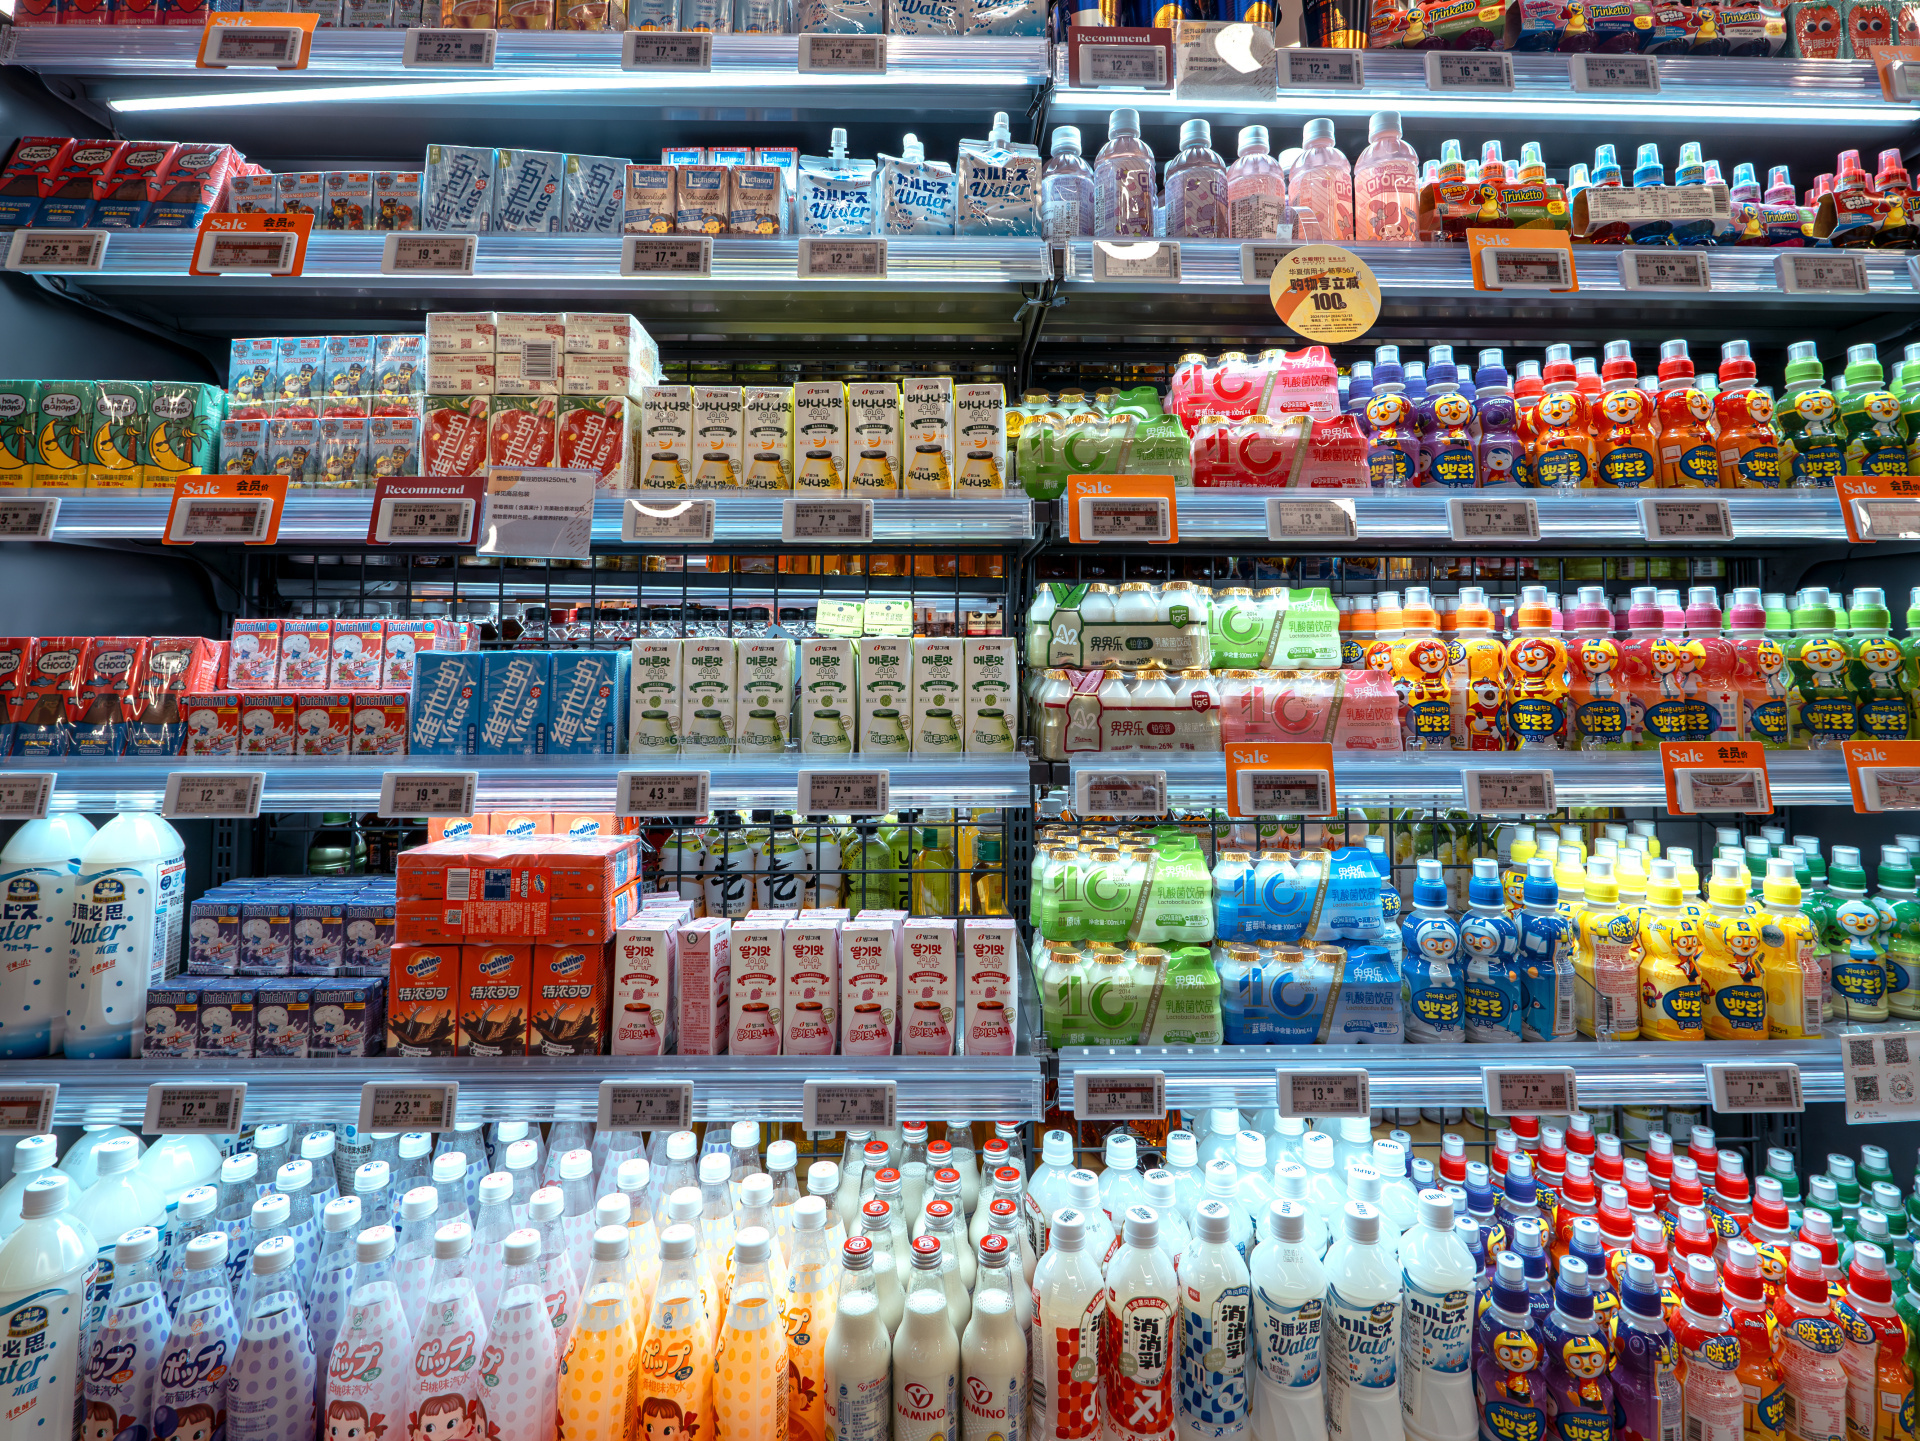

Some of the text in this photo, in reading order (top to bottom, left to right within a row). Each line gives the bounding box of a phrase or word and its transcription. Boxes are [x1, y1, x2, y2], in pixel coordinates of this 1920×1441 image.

[1592, 6, 1630, 16] Trinketto
[1722, 12, 1761, 23] Trinketto
[1077, 33, 1150, 43] Recommend
[671, 154, 697, 164] Lactasoy
[635, 172, 667, 186] Lactasoy
[688, 172, 719, 186] Lactasoy
[741, 173, 772, 187] Lactasoy
[973, 167, 1029, 181] カルピス
[897, 173, 948, 194] カルピス
[970, 181, 1031, 197] Water
[895, 188, 951, 209] Water
[1503, 190, 1543, 203] Trinketto
[263, 218, 295, 227] 会员价
[1764, 211, 1797, 222] Trinketto
[209, 219, 247, 230] Sale
[1476, 235, 1510, 246] Sale
[1290, 277, 1359, 291] 购物享立减
[798, 398, 842, 408] 바나나맛
[852, 398, 896, 408] 바나나맛
[907, 393, 950, 403] 바나나맛
[959, 399, 1002, 410] 바나나맛
[645, 401, 690, 412] 바나나맛
[696, 401, 741, 412] 바나나맛
[181, 481, 220, 495] Sale
[236, 480, 269, 492] 会员价
[385, 484, 465, 495] Recommend
[1076, 482, 1112, 494] Sale
[1843, 482, 1878, 494] Sale
[1172, 613, 1187, 622] IgG
[1091, 636, 1149, 651] 界界乐 铂金装
[639, 656, 670, 667] 메론맛
[692, 656, 723, 667] 메론맛
[746, 656, 777, 667] 메론맛
[868, 655, 899, 666] 메론맛
[922, 655, 953, 666] 메론맛
[973, 655, 1004, 666] 메론맛
[1194, 698, 1208, 707] IgG
[1111, 720, 1171, 736] 界界乐 铂金装
[1513, 713, 1554, 731] 뽀로로
[1158, 742, 1172, 750] 26%
[1233, 750, 1268, 764] Sale
[1669, 749, 1704, 763] Sale
[1717, 747, 1748, 759] 会员价
[1852, 748, 1887, 761] Sale
[443, 821, 473, 839] Ovaltine
[1157, 887, 1205, 899] 乳酸菌饮品
[1331, 888, 1376, 902] 乳酸菌饮品
[1067, 916, 1081, 926] 原味
[71, 922, 127, 945] Water
[623, 945, 654, 958] 딸기맛
[739, 945, 771, 958] 딸기맛
[793, 944, 824, 958] 딸기맛
[851, 946, 882, 960] 딸기맛
[911, 944, 942, 956] 딸기맛
[973, 944, 1004, 957] 딸기맛
[406, 956, 442, 974] Ovaltine
[479, 954, 515, 973] Ovaltine
[550, 954, 586, 973] Ovaltine
[399, 986, 450, 1001] 特浓可可
[470, 985, 522, 999] 特浓可可
[542, 984, 593, 998] 特浓可可
[1346, 992, 1393, 1005] 乳酸菌饮品
[1166, 1000, 1214, 1013] 乳酸菌饮品
[1418, 1000, 1459, 1020] 뽀로로
[1411, 1299, 1468, 1324] カルピス
[1338, 1314, 1392, 1338] カルピス
[1798, 1322, 1844, 1346] 啵乐乐
[1133, 1316, 1163, 1370] 消消乳
[1269, 1334, 1320, 1356] Water
[330, 1343, 383, 1380] ポップ
[417, 1333, 475, 1380] ポップ
[642, 1341, 692, 1380] ポップ
[164, 1342, 226, 1386] ポップ
[420, 1373, 470, 1392] 白桃味汽水
[164, 1382, 219, 1403] 葡萄味汽水
[897, 1406, 945, 1421] VAMINO
